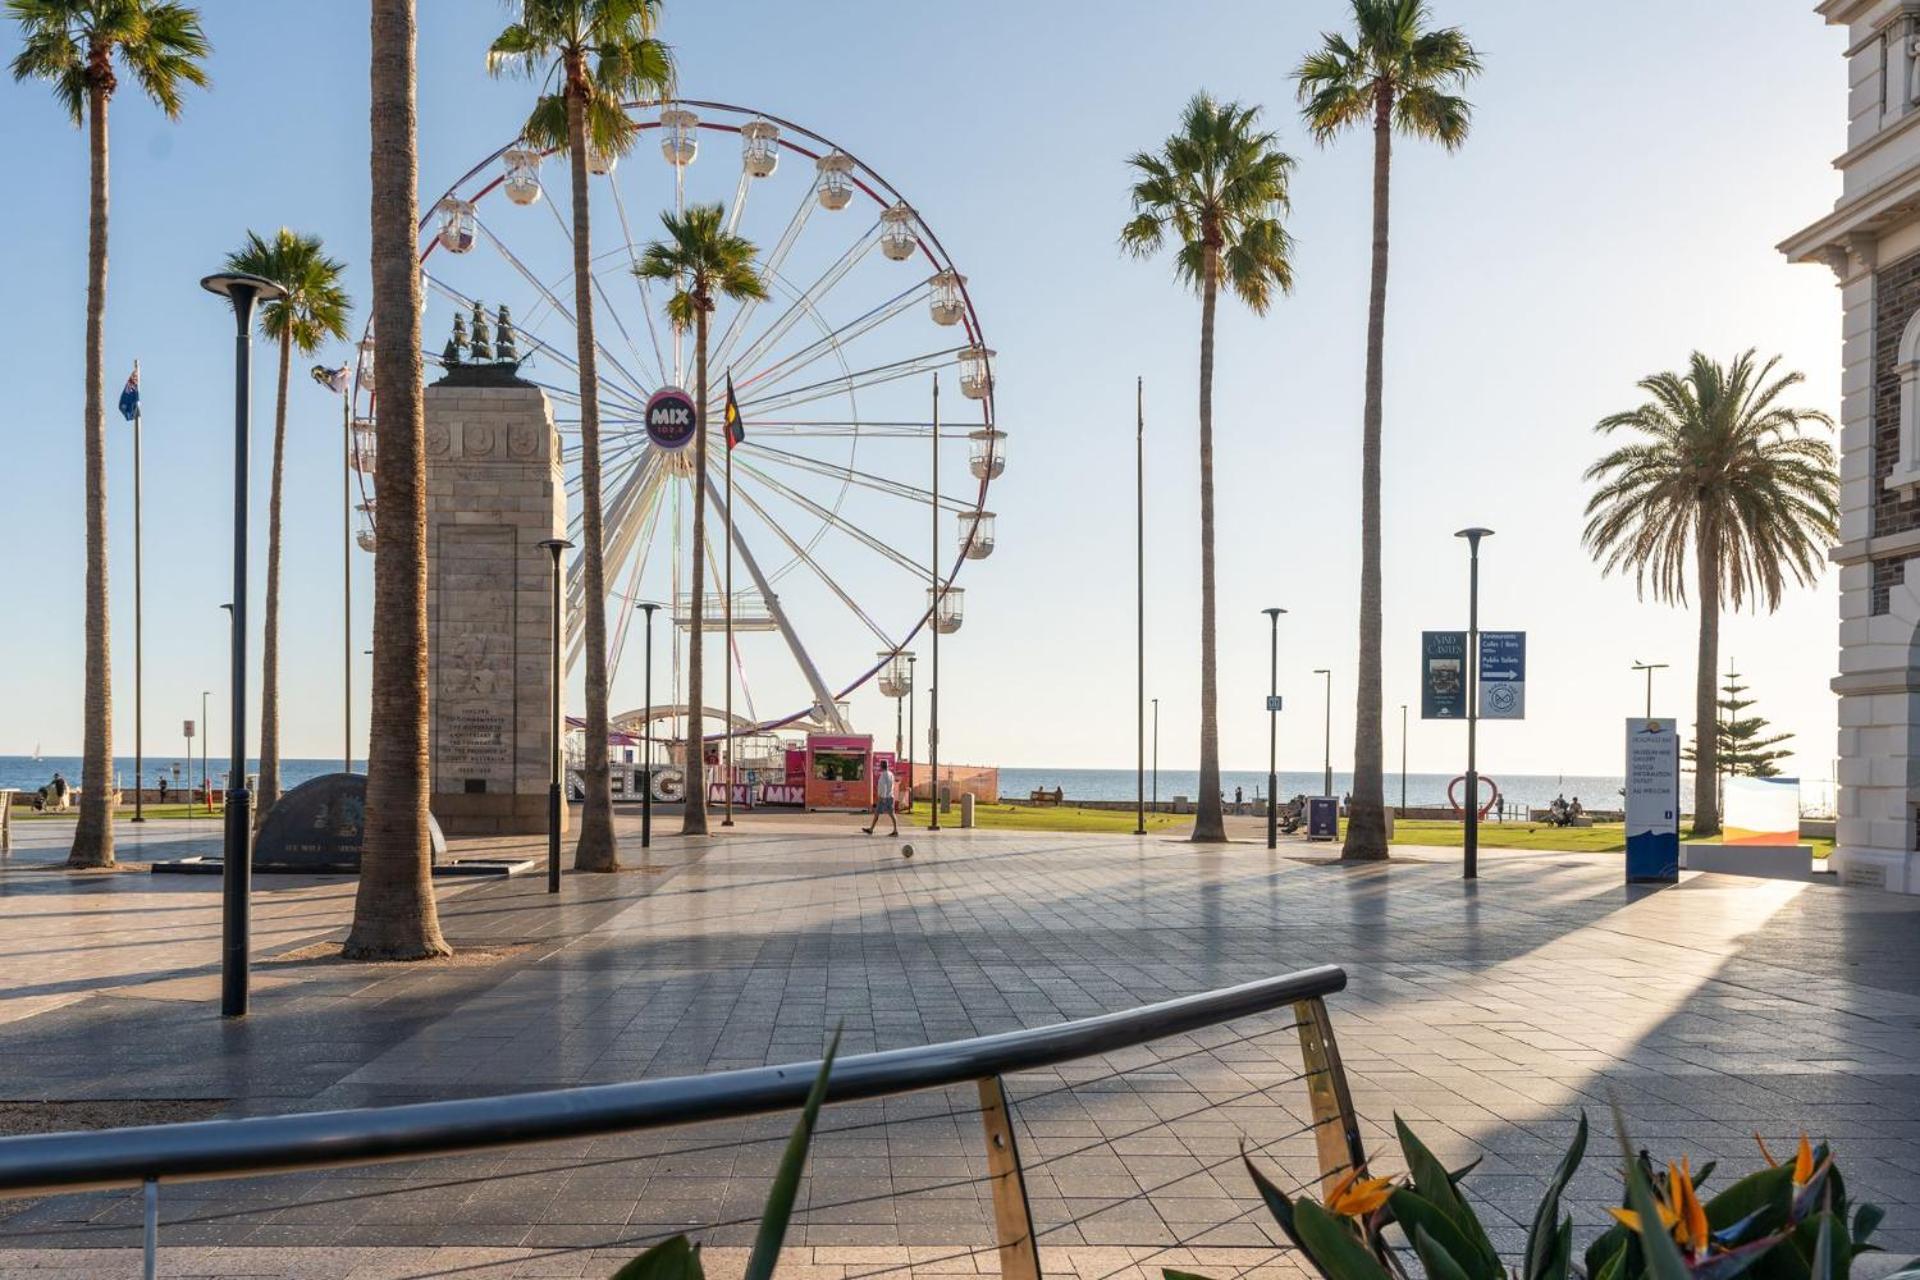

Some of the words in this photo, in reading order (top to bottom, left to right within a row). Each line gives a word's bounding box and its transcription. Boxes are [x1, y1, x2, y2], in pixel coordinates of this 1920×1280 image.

[651, 408, 689, 425] MIX
[711, 785, 745, 803] MX
[766, 786, 805, 803] MIX
